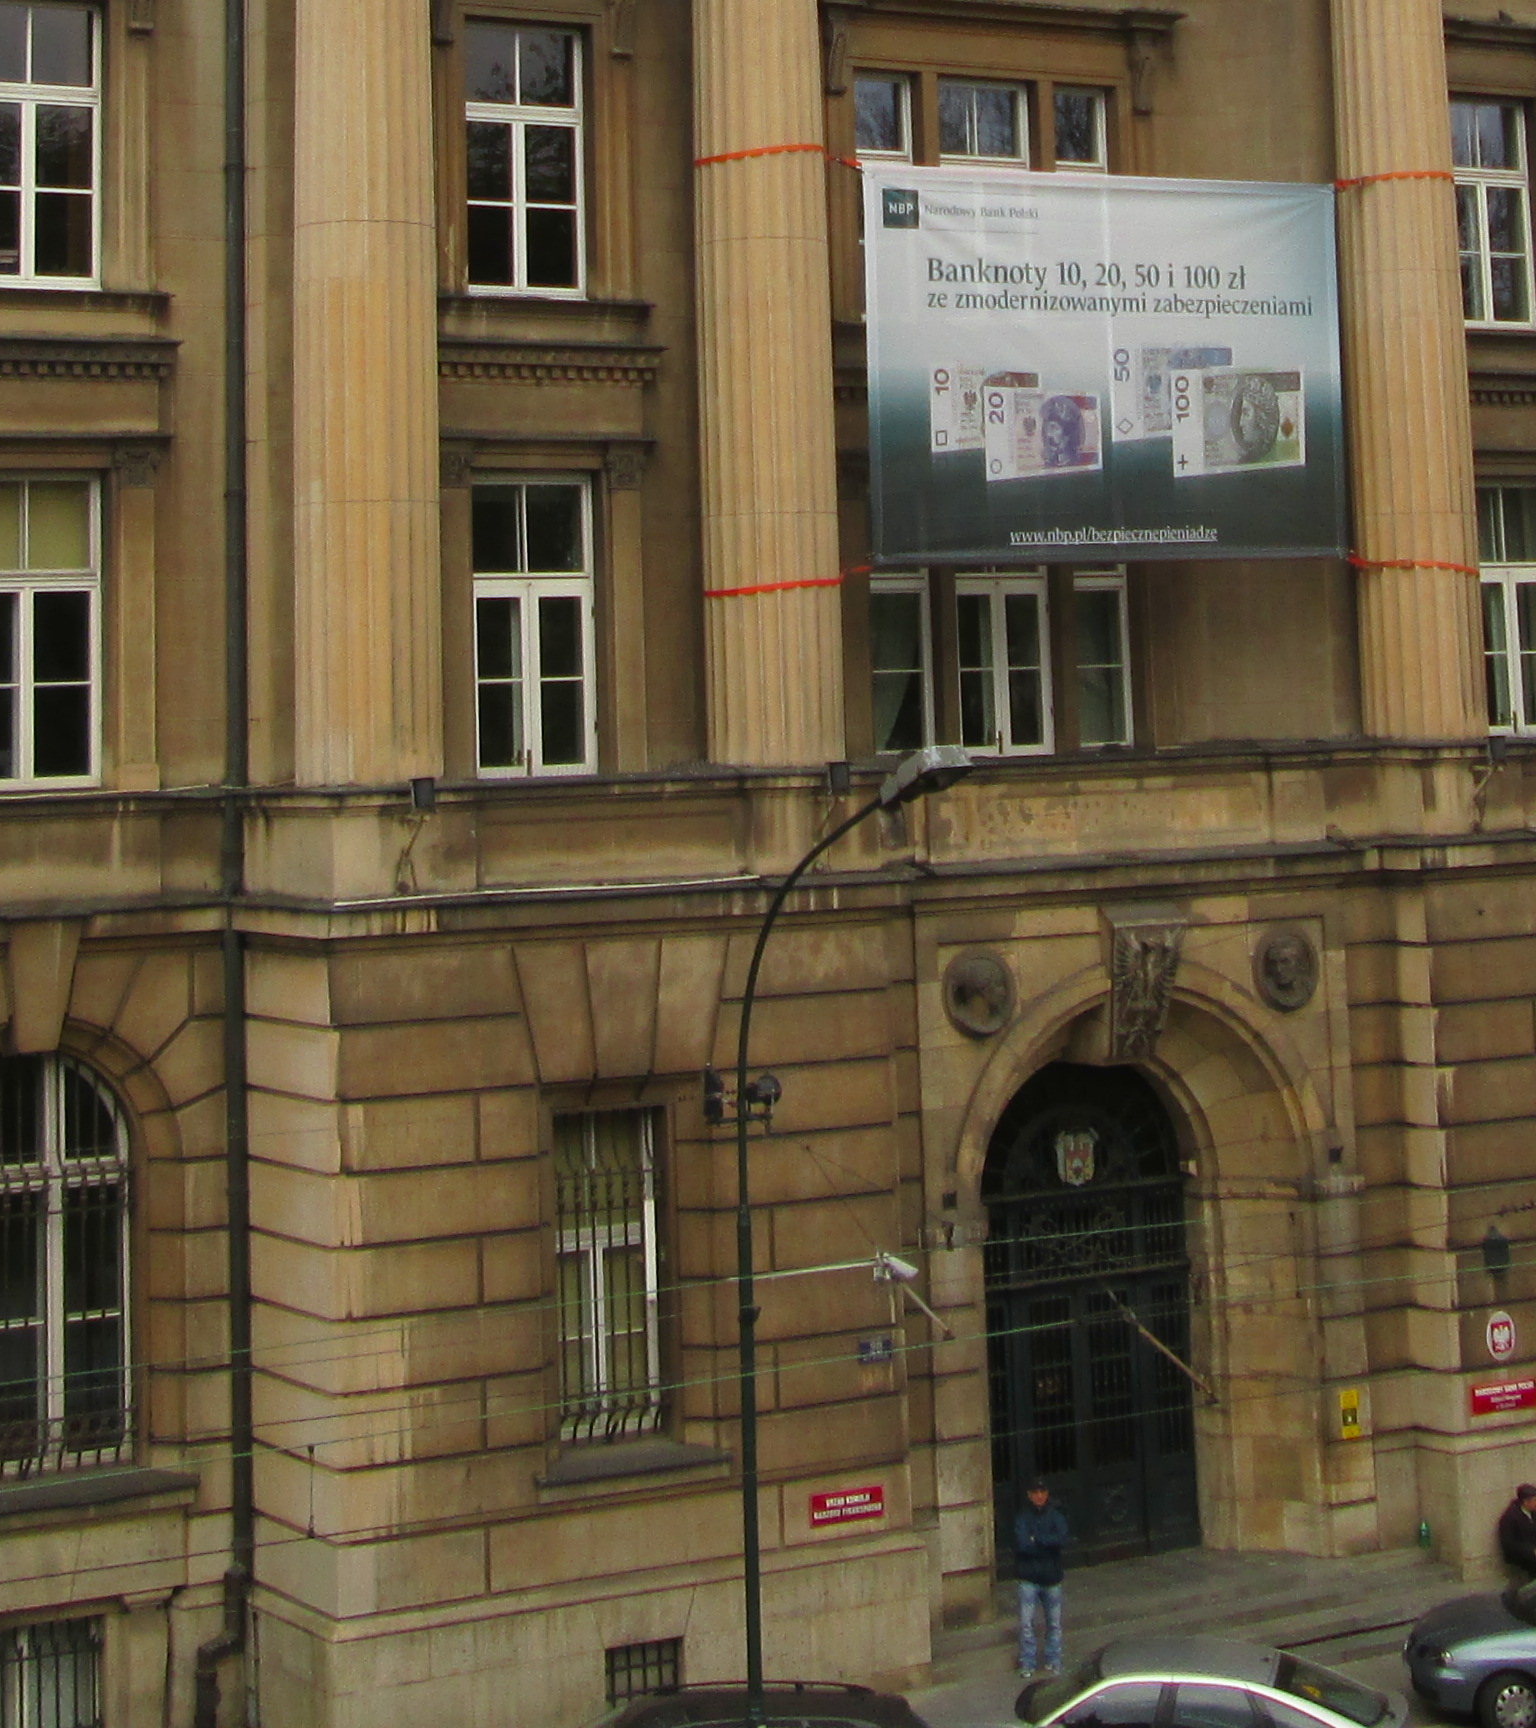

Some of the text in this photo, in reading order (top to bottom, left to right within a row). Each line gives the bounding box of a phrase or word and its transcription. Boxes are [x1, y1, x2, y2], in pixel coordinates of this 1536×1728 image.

[888, 201, 914, 215] NBP
[924, 203, 1039, 220] Narodowy Bank Polski
[927, 257, 1246, 292] Banknoty 10, 20, 50 i 100 zł
[927, 289, 1313, 319] ze zmodernizowanymi zabezpieczeniami
[1114, 348, 1131, 382] 50
[934, 368, 950, 396] 10
[988, 392, 1005, 425] 20
[1174, 376, 1191, 424] 100
[1010, 525, 1219, 546] www.nbp.pl/bezpiecznepieniadze
